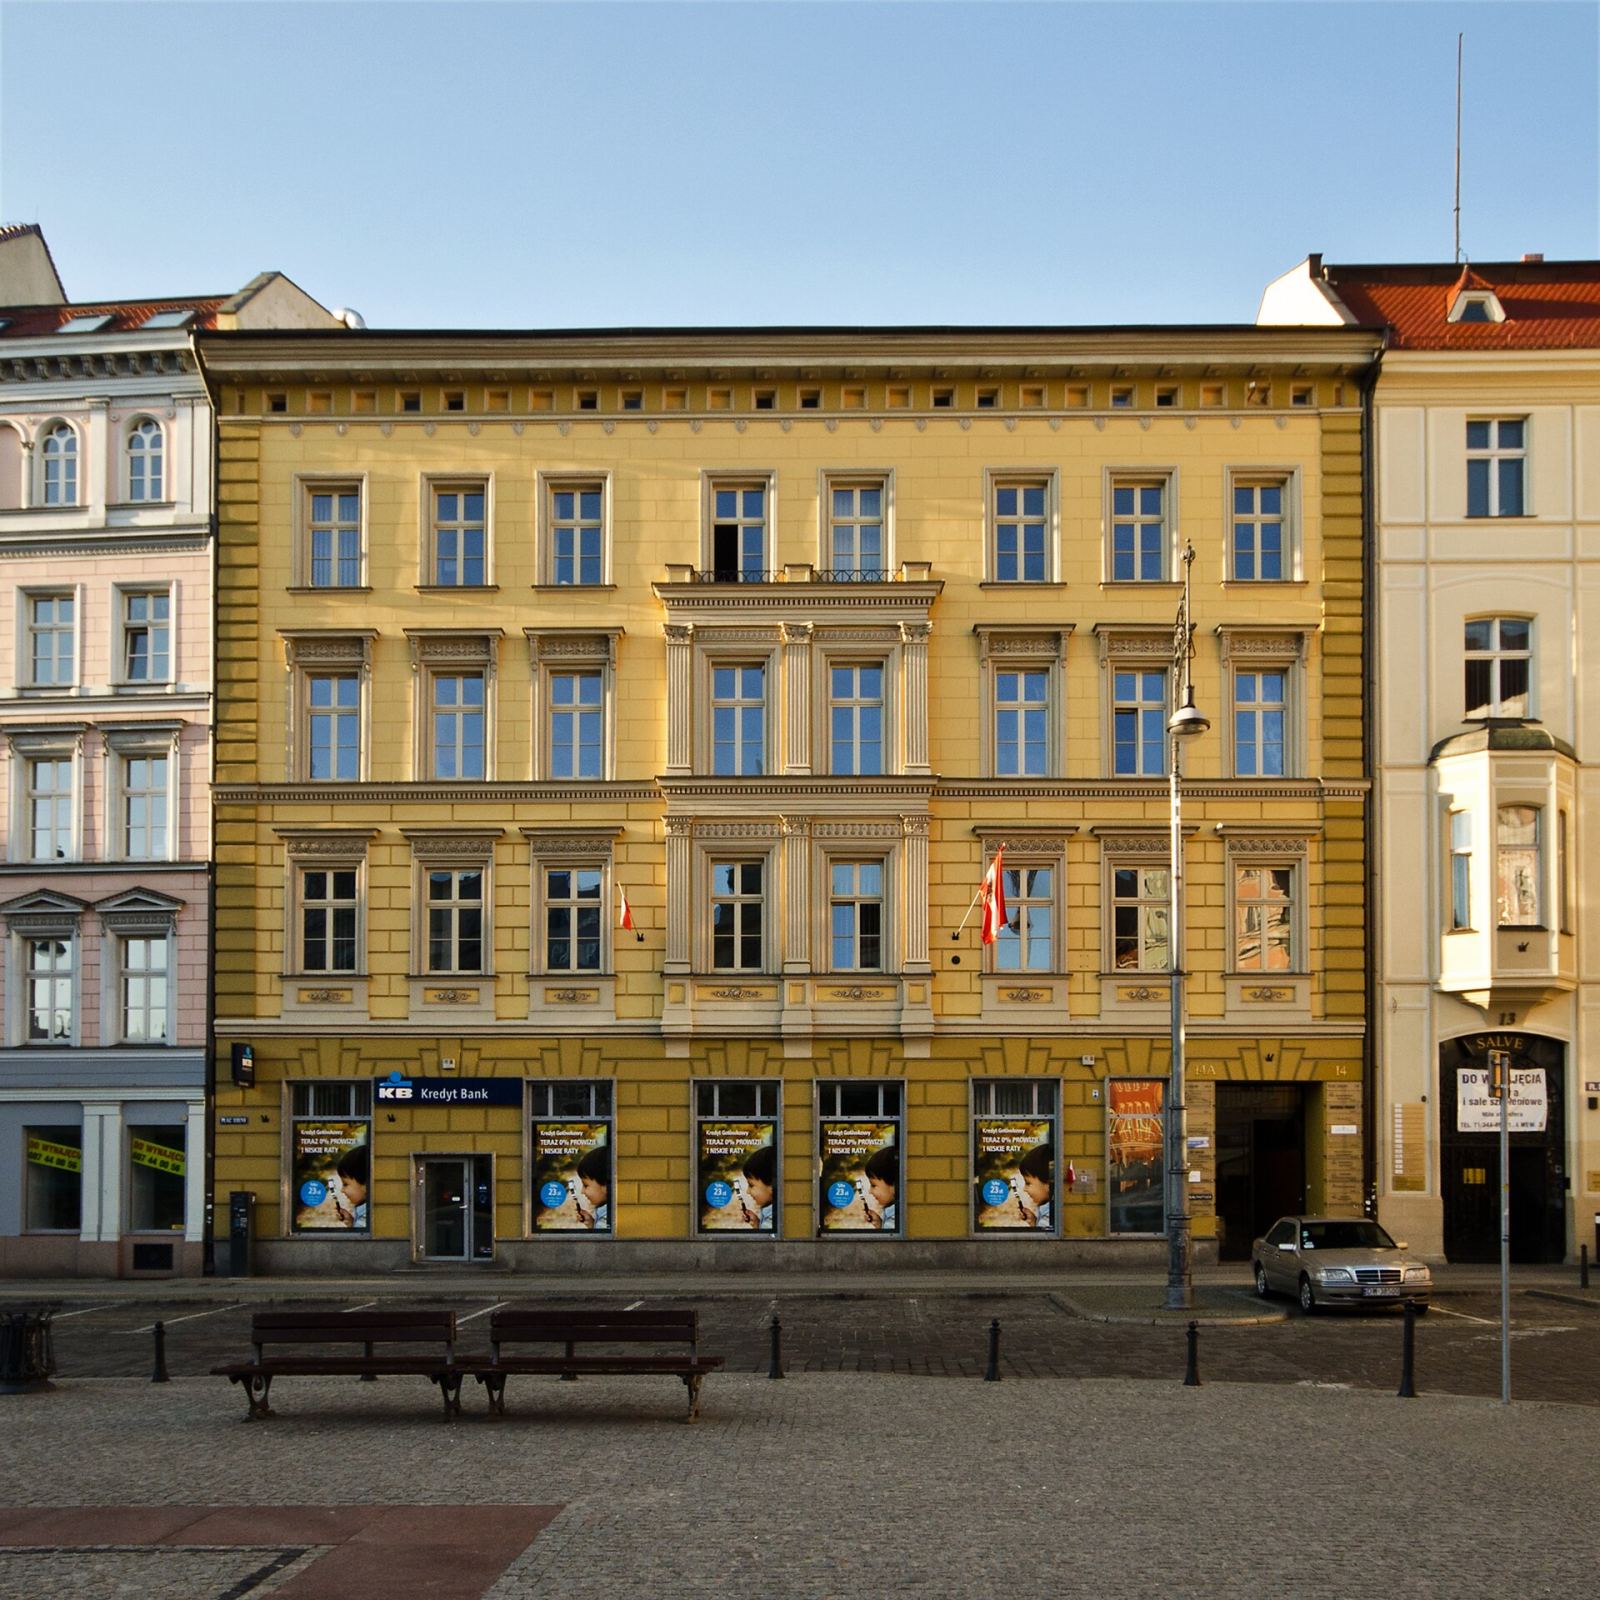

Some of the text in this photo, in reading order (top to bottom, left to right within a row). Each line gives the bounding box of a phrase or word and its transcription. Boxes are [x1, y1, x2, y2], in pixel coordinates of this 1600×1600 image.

[1499, 1013, 1516, 1026] 13
[1476, 1035, 1523, 1049] SALVE
[1195, 1065, 1216, 1075] 14A
[1336, 1065, 1347, 1075] 14
[1462, 1074, 1542, 1086] DO WJĘCIA
[378, 1088, 413, 1099] KB
[421, 1088, 488, 1101] Kredyt Bank
[1469, 1097, 1487, 1106] sale
[44, 1154, 53, 1163] 44
[147, 1155, 157, 1164] 44
[548, 1188, 556, 1196] 23
[714, 1188, 722, 1196] 23
[836, 1188, 844, 1196] 23
